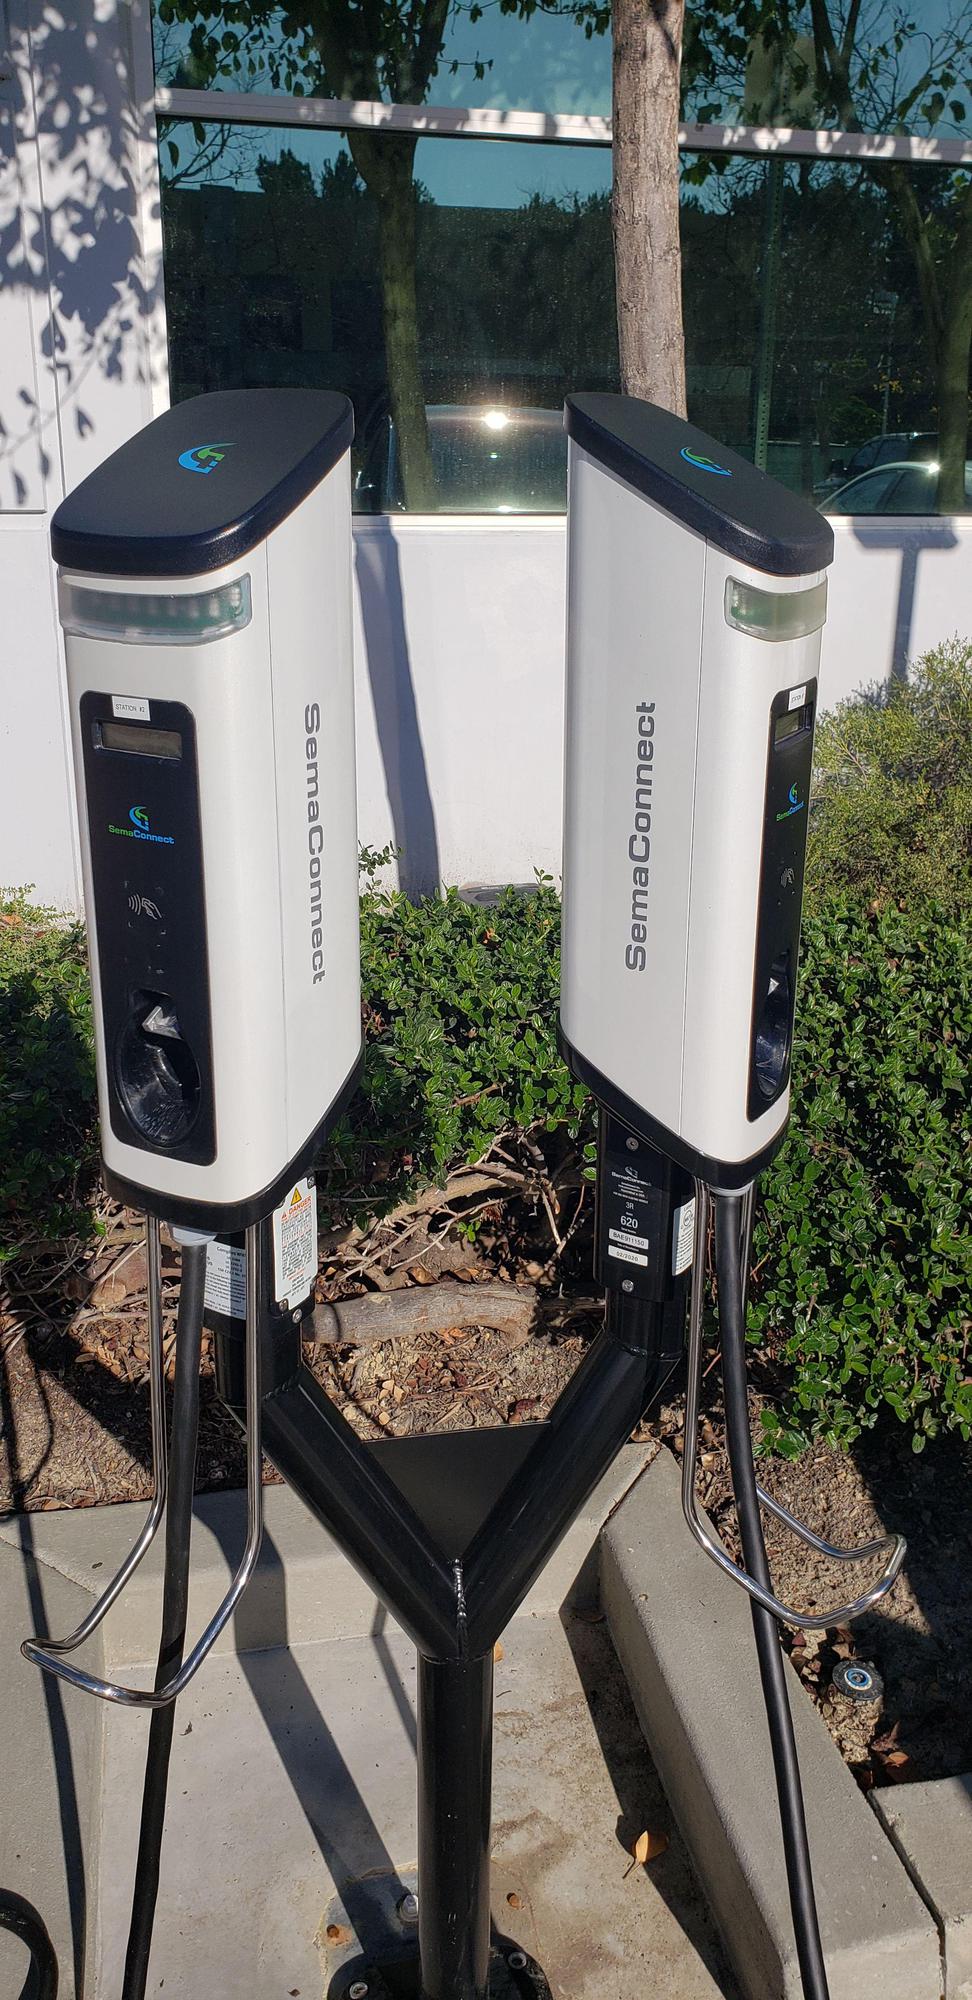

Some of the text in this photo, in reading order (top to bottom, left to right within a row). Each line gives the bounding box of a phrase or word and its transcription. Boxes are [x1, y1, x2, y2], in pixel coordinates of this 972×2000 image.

[115, 703, 137, 712] STATION
[108, 824, 175, 845] SemaConnect
[305, 702, 326, 985] SemaConnect
[625, 701, 656, 972] SemaConnect
[288, 1195, 312, 1215] DANGER
[625, 1201, 634, 1210] 3R
[620, 1215, 639, 1229] 620
